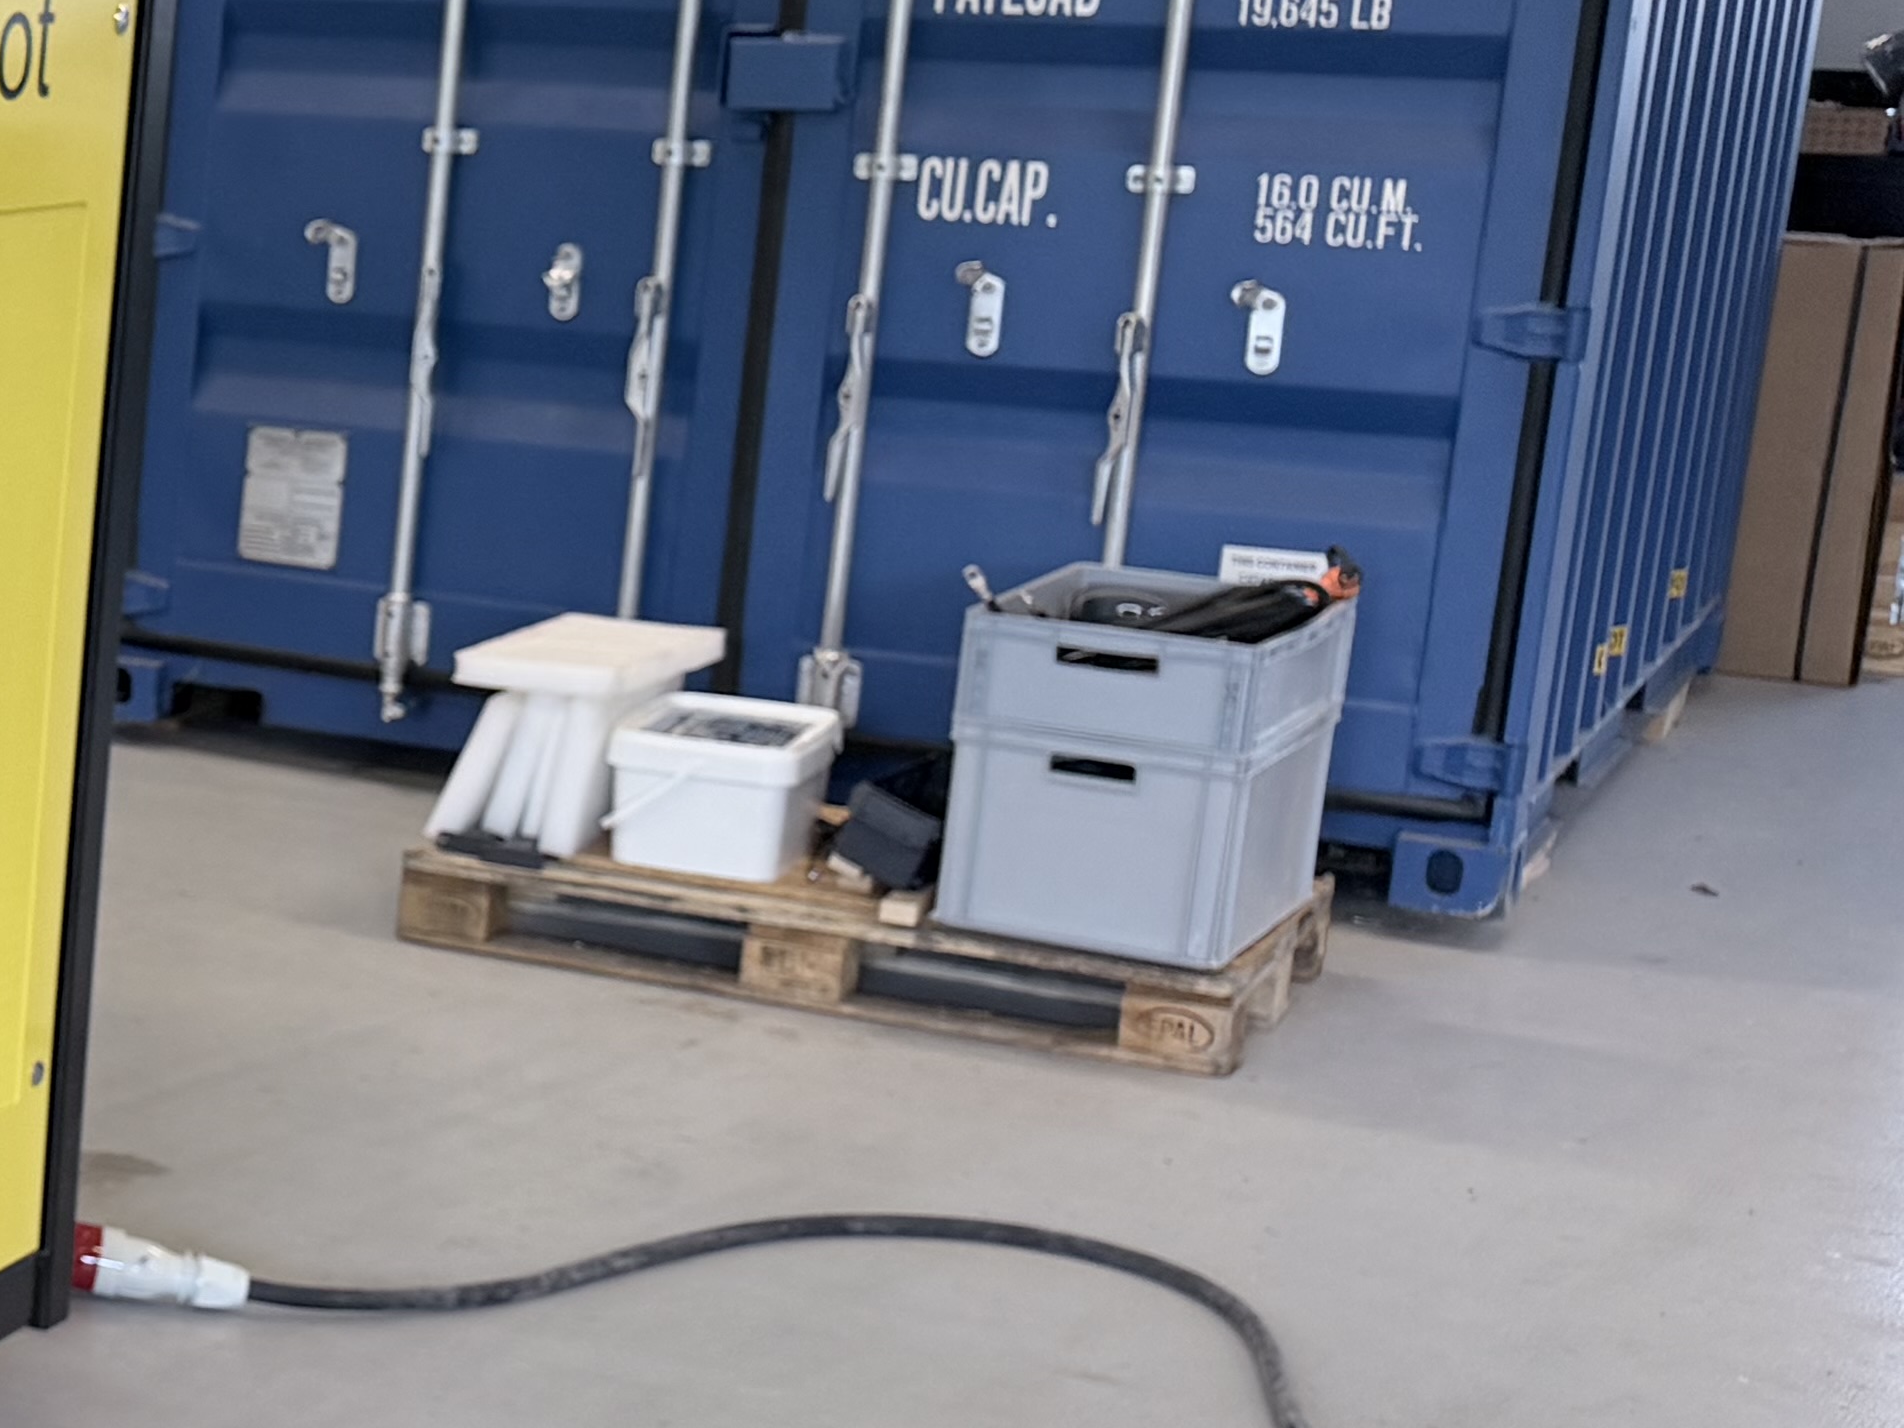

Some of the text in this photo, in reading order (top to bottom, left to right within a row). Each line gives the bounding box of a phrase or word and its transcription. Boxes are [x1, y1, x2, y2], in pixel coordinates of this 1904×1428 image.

[1257, 173, 1320, 212] 16.0
[1254, 207, 1423, 252] 564 CU.FT.
